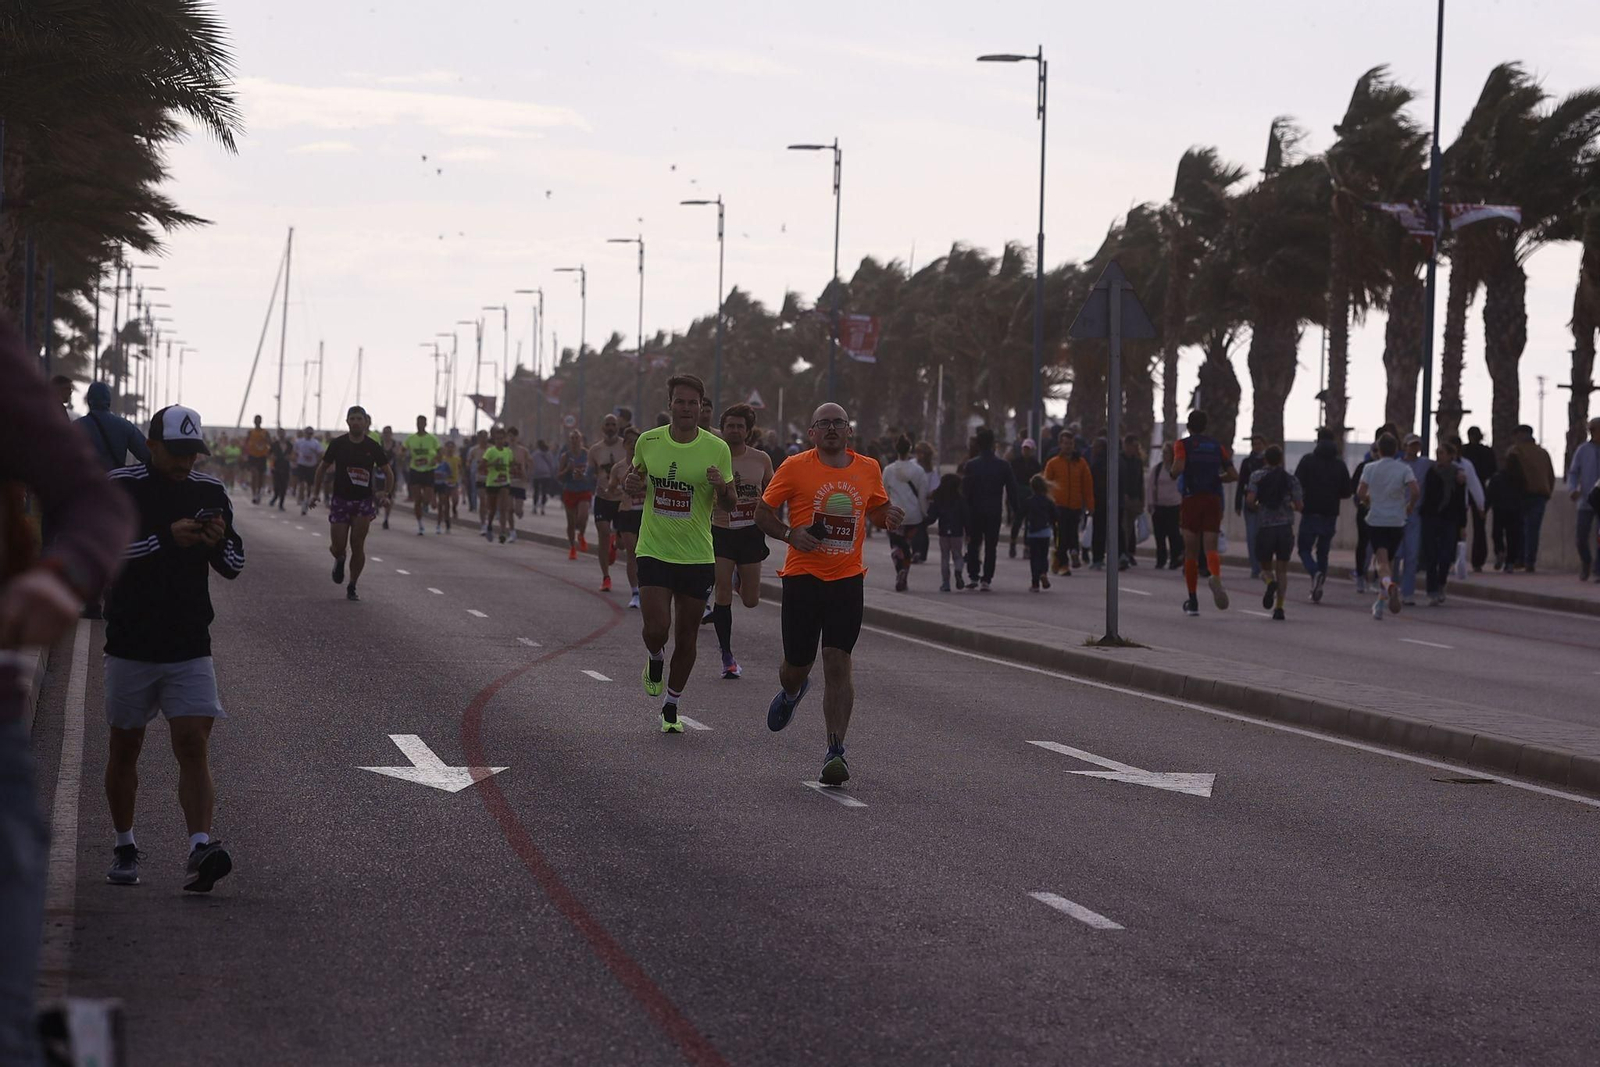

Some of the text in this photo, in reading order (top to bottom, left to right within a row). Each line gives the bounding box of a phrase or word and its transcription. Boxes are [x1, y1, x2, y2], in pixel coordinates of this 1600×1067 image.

[649, 474, 695, 495] BRUNCH
[837, 480, 863, 506] CHICAGO
[672, 499, 690, 508] 1331
[836, 526, 851, 536] 732
